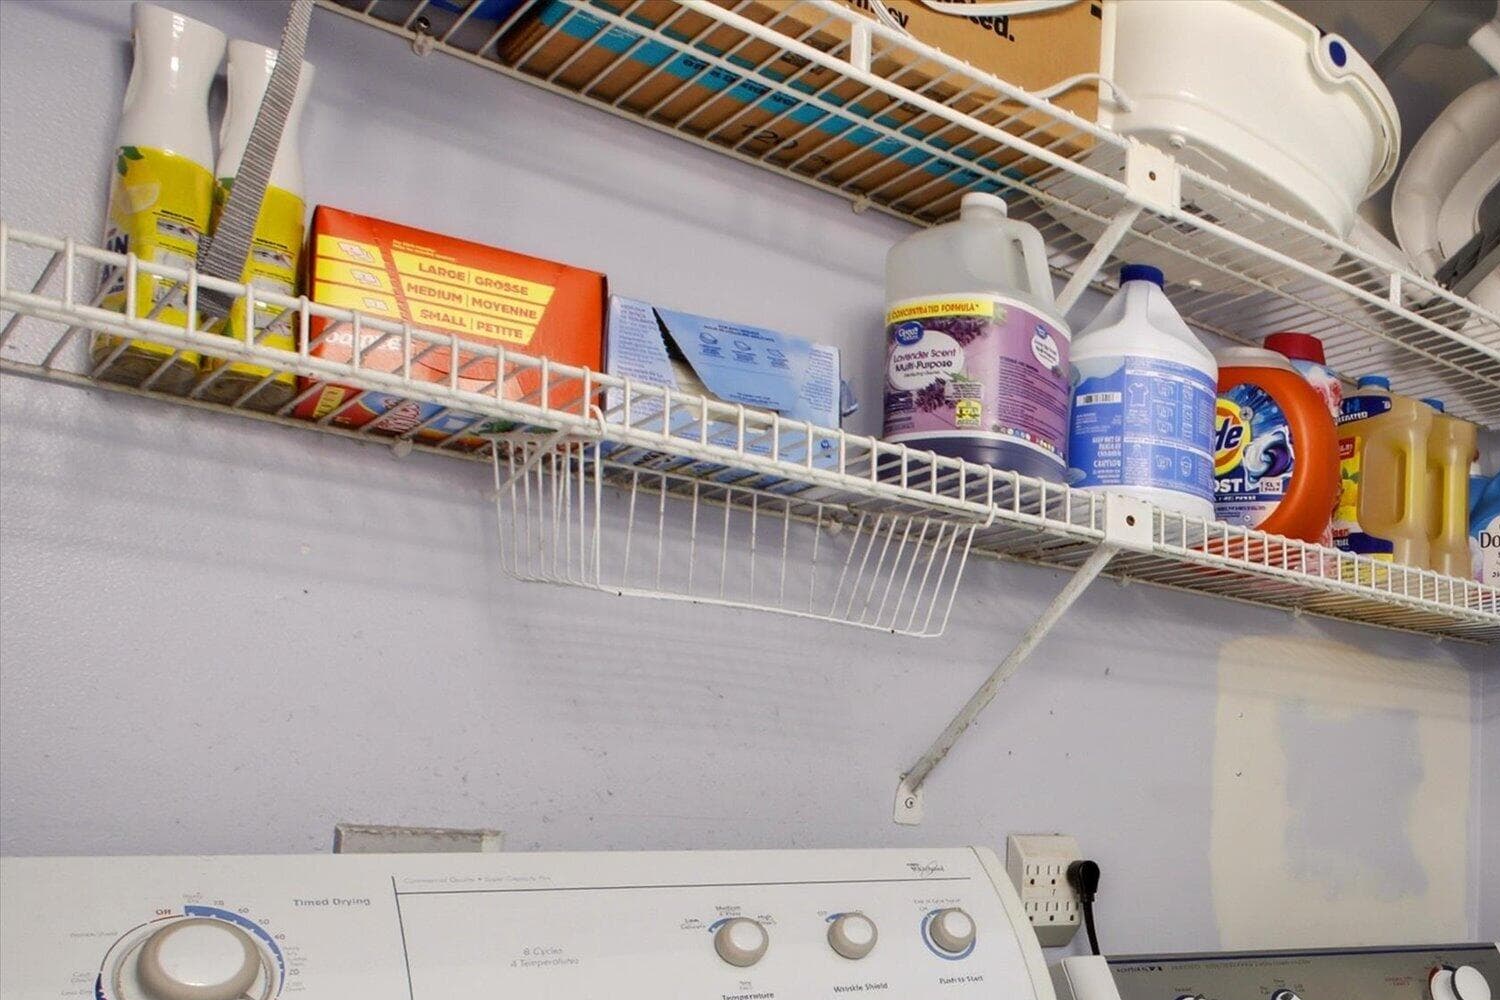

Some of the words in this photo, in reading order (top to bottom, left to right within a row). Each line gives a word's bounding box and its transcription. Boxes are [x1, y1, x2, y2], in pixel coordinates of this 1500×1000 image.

[418, 262, 466, 282] LARGE
[474, 276, 529, 297] GROSSE
[406, 282, 463, 304] MEDIUM
[471, 296, 537, 320] MOYENNE
[420, 308, 467, 328] SMALL
[476, 320, 524, 339] PETITE
[893, 351, 929, 363] Lavender
[931, 348, 957, 358] Scent
[896, 360, 953, 372] Multi-Purpose
[293, 898, 328, 907] Timed
[333, 897, 371, 907] Drying
